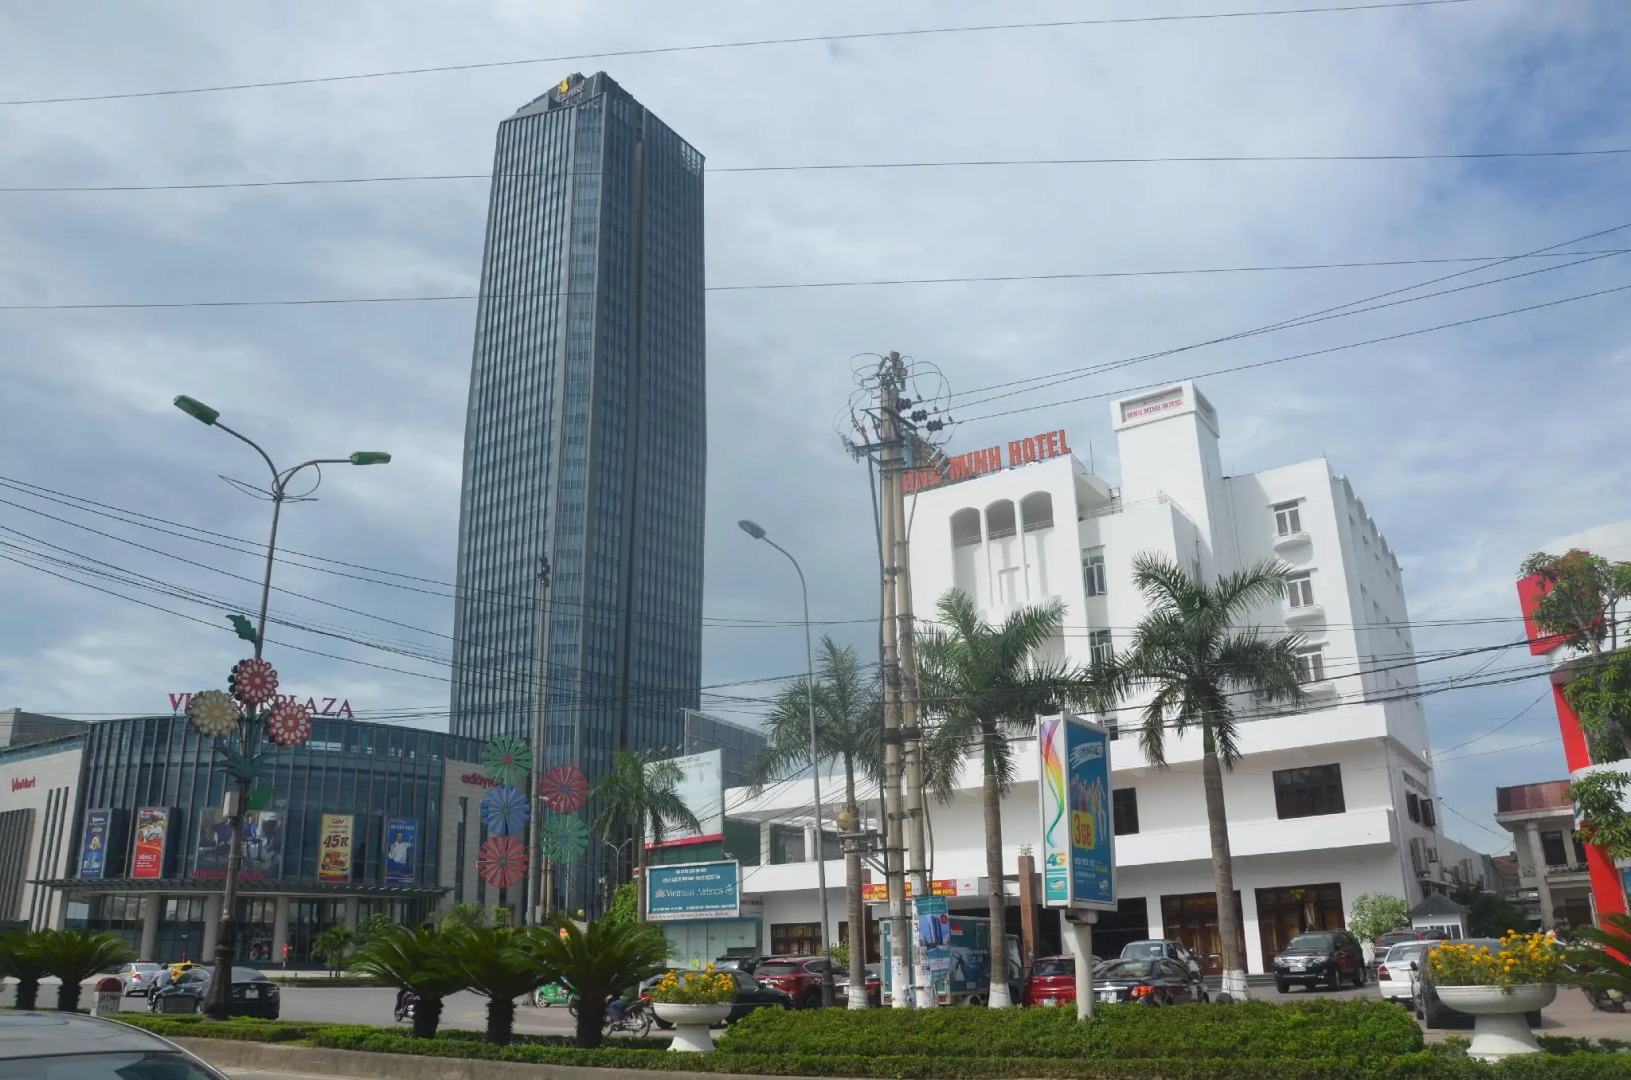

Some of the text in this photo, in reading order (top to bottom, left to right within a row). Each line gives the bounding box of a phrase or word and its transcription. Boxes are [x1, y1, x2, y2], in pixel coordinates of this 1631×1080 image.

[951, 446, 1002, 481] MINH
[1008, 429, 1072, 466] HOTEL
[1074, 813, 1092, 846] 3GB
[323, 834, 349, 848] 45K
[1047, 852, 1067, 866] 4G
[666, 887, 724, 897] Vietnam Airlines
